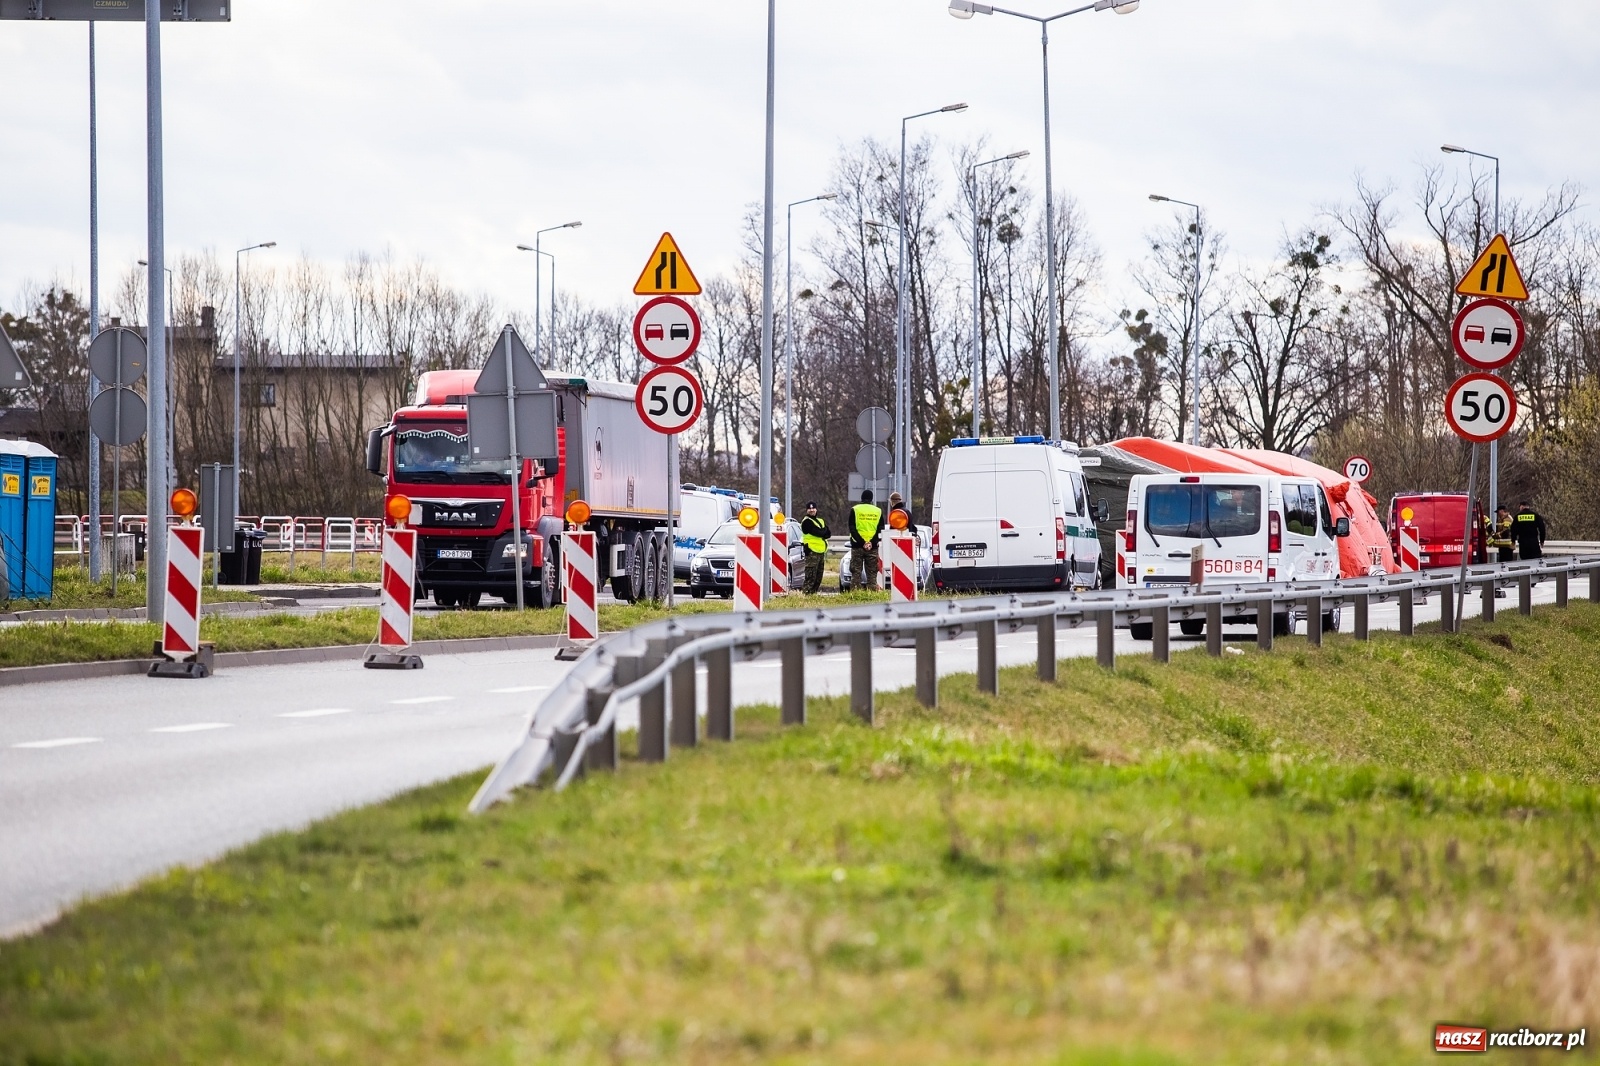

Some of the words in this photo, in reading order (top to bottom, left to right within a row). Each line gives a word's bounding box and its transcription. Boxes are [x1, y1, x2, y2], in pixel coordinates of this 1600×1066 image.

[649, 385, 694, 417] 50
[1459, 390, 1506, 424] 50
[1349, 463, 1369, 477] 70
[434, 512, 477, 522] MAN
